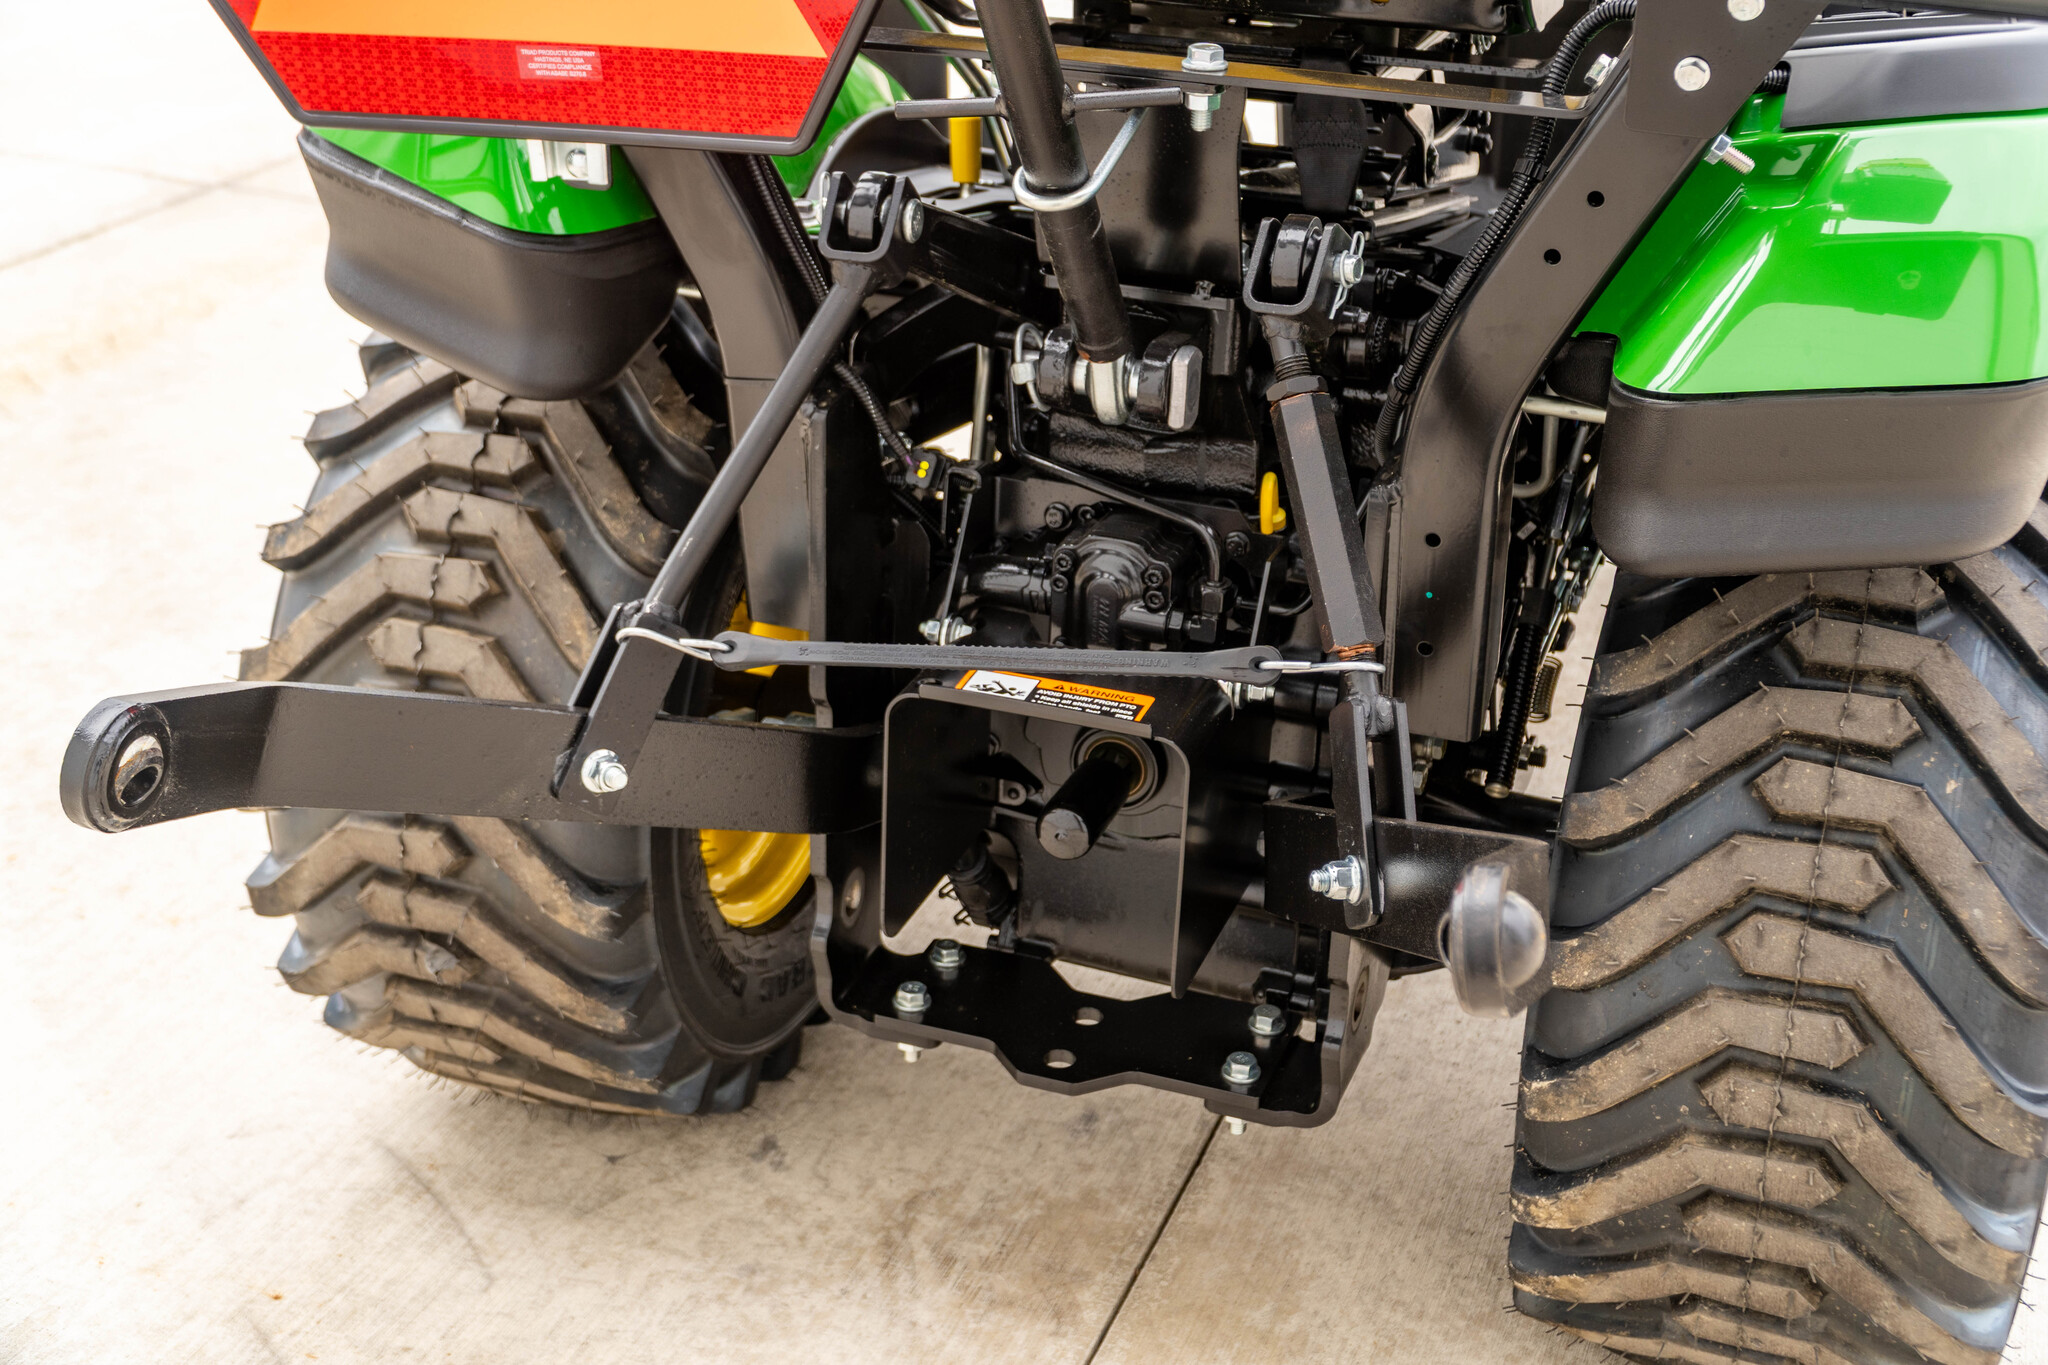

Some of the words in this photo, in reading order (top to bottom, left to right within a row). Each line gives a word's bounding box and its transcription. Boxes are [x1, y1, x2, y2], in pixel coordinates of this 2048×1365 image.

[1036, 689, 1062, 697] AVOID
[1063, 693, 1093, 702] INJURY
[1094, 699, 1118, 707] FROM
[1119, 702, 1137, 710] PTO
[1070, 686, 1136, 702] WARNING
[1040, 695, 1060, 703] Keep
[1072, 701, 1101, 710] shields
[1110, 707, 1133, 715] place
